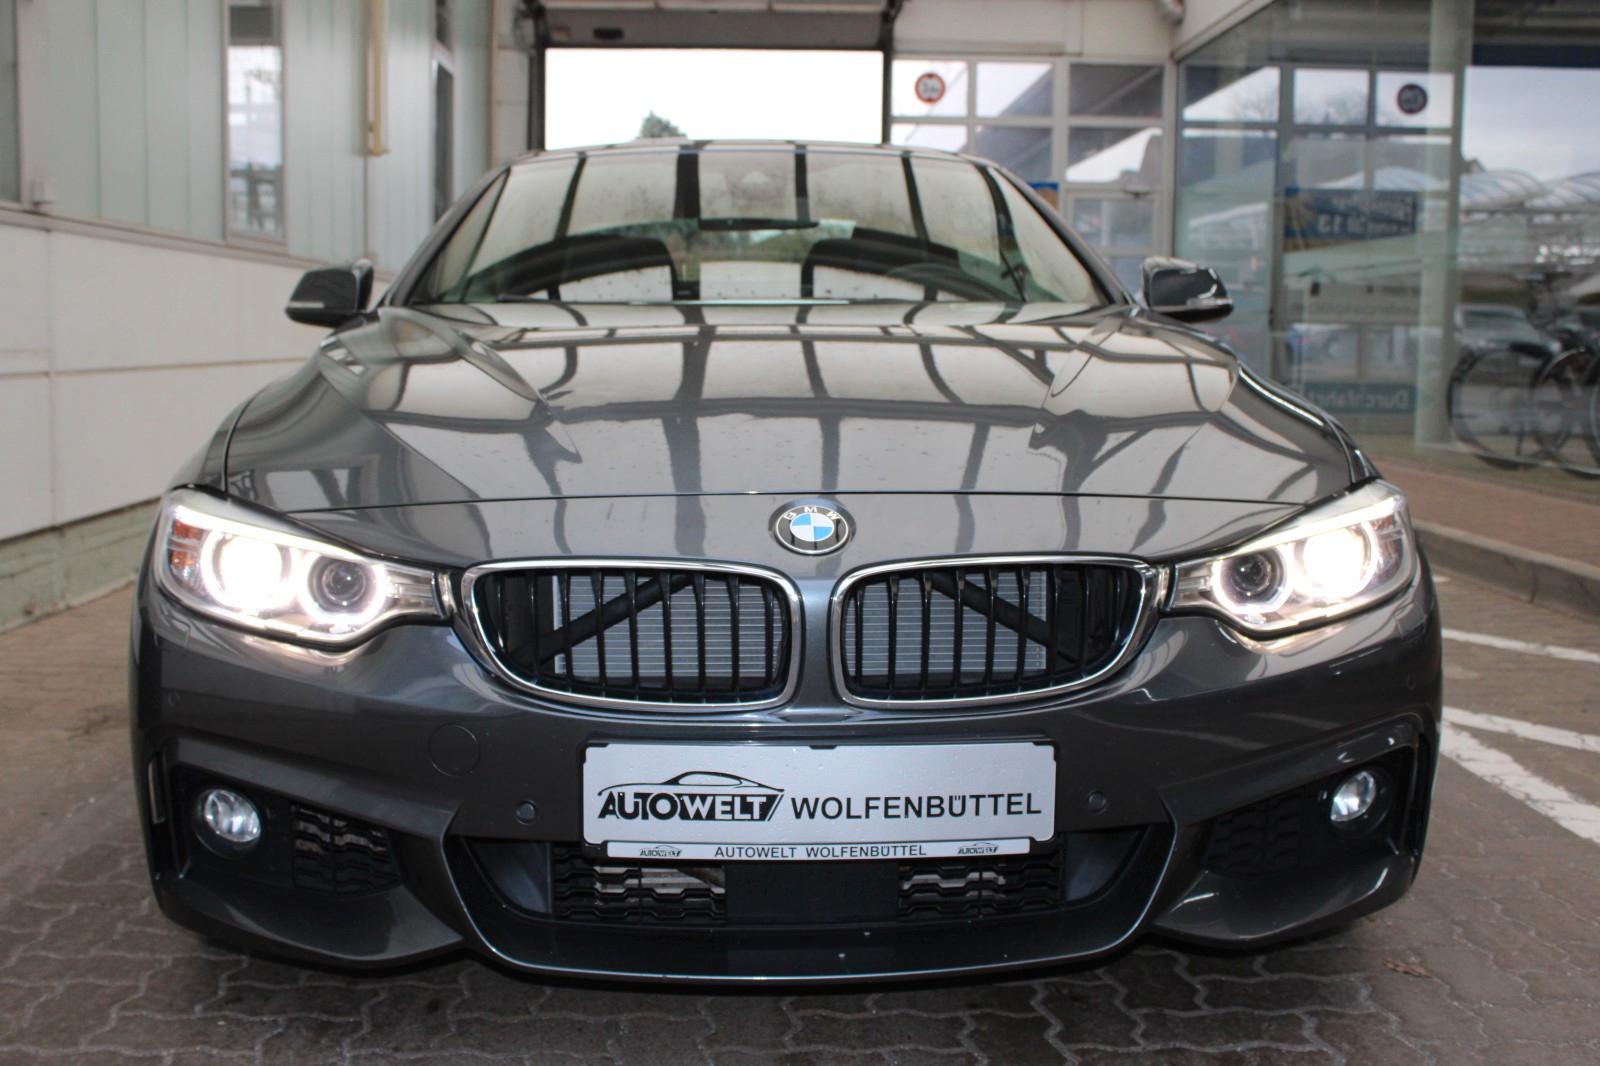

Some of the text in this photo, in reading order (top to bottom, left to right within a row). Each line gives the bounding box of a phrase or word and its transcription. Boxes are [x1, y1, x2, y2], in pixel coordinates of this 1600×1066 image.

[783, 506, 841, 521] BMW
[598, 791, 1042, 821] AUTOWELT WOLFENBÜTTEL
[714, 845, 927, 859] AUTOWELT WOLFENBÜTTEL
